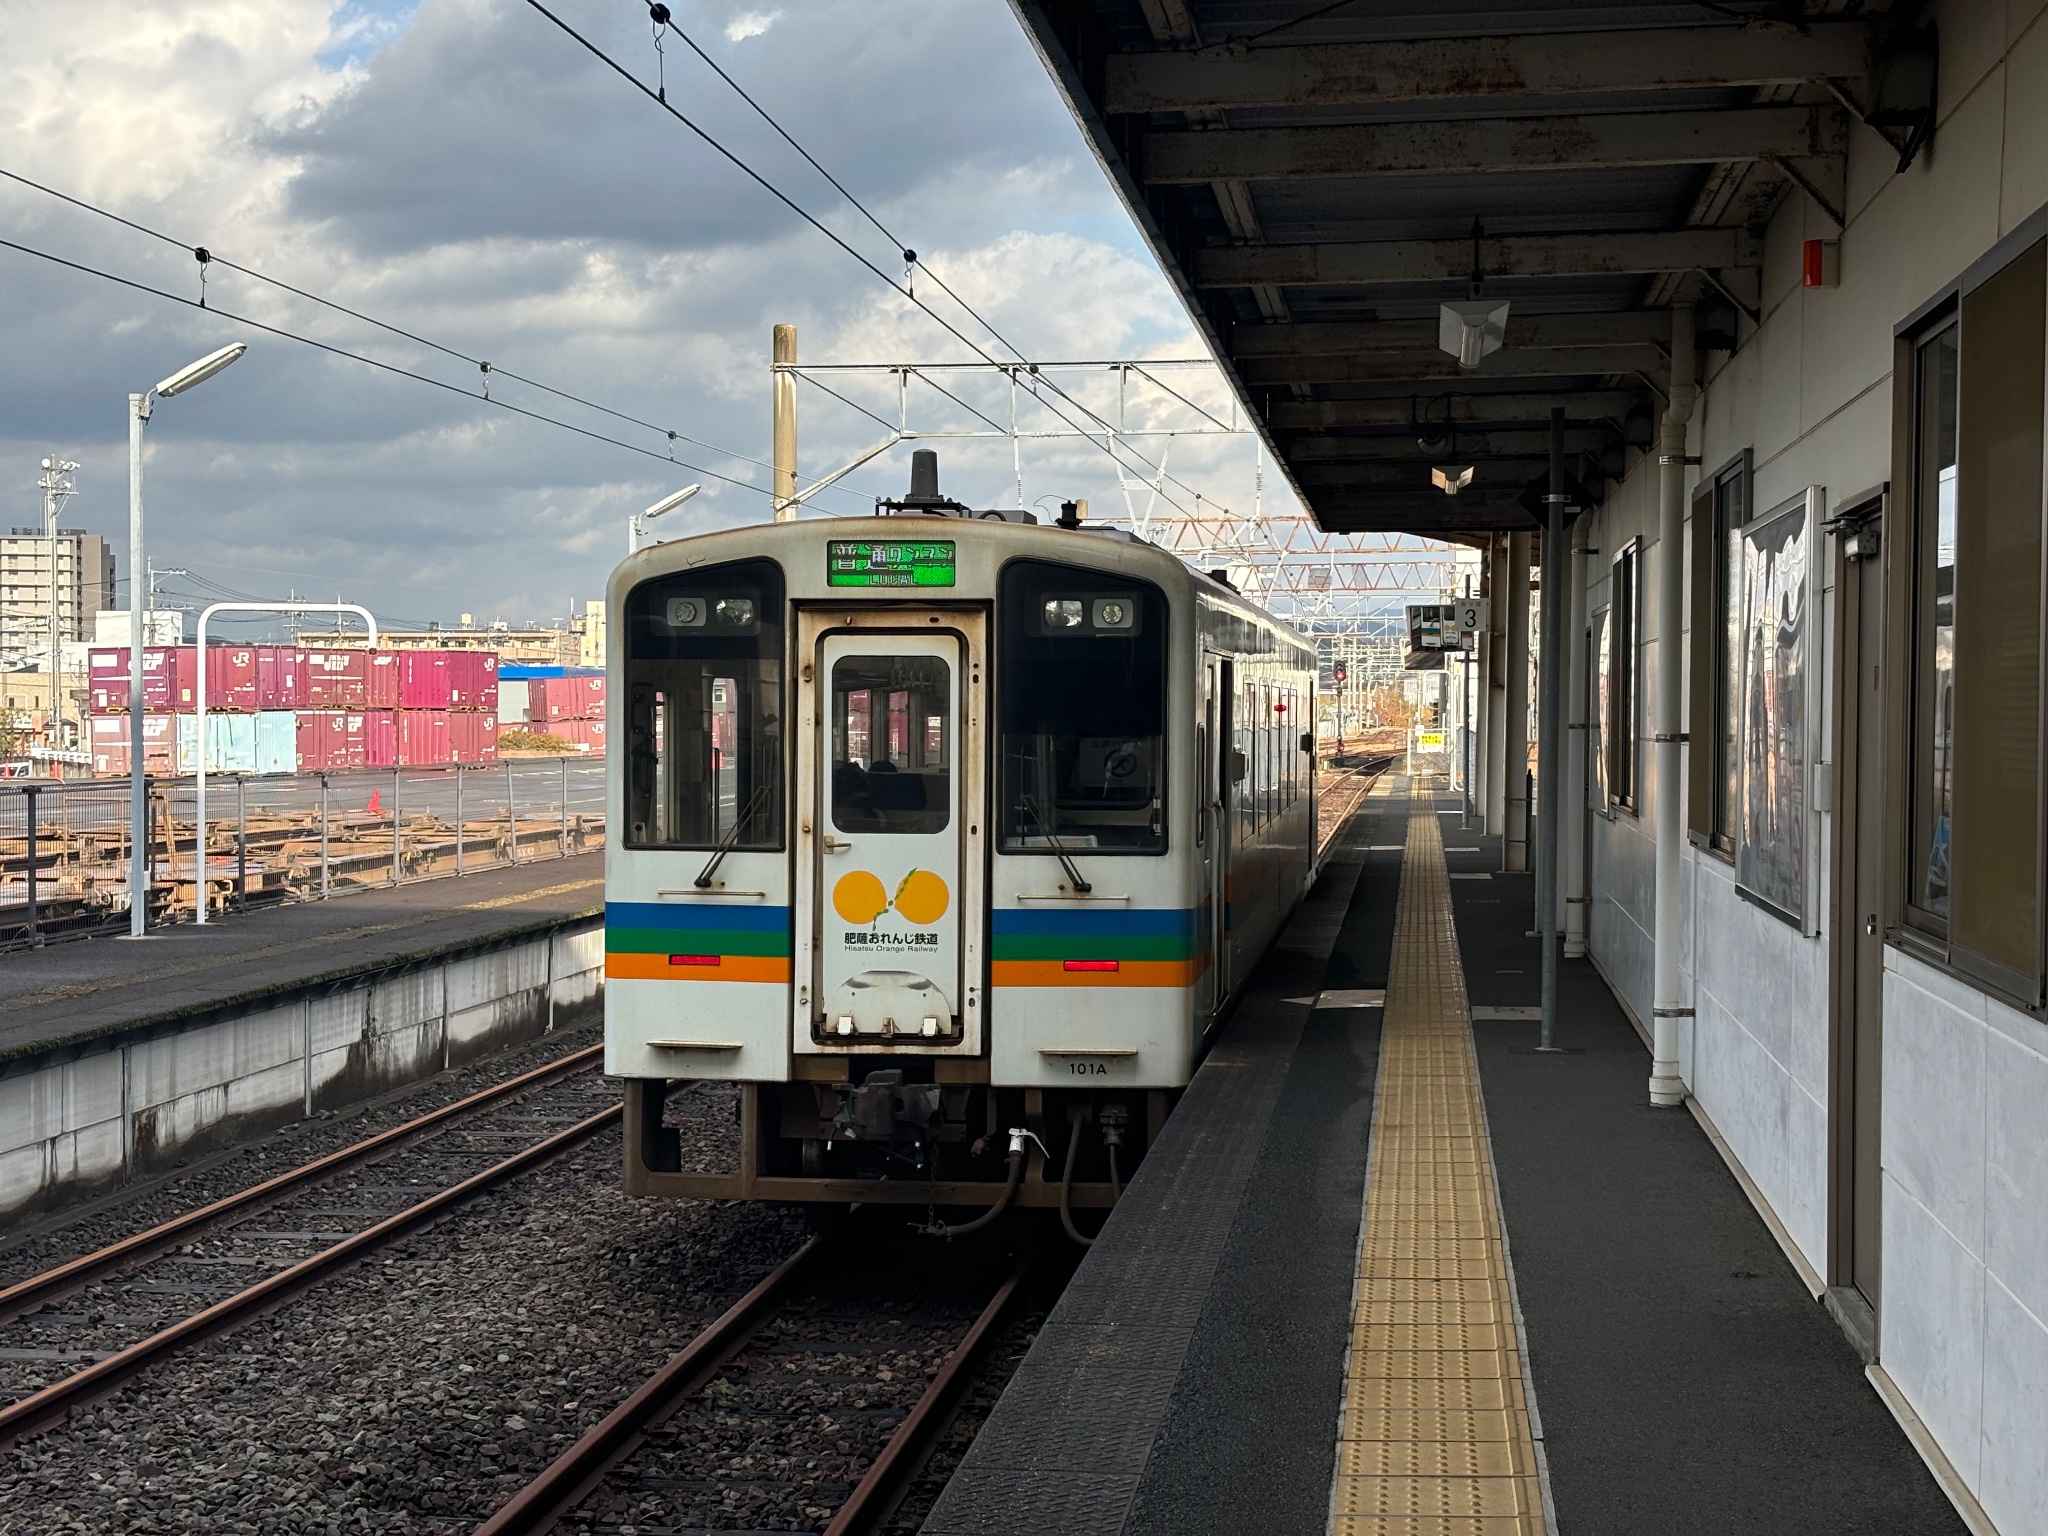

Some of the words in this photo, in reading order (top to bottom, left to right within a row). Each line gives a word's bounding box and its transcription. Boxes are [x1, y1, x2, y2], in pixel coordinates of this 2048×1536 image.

[1464, 608, 1476, 628] 3
[844, 932, 938, 945] 肥薩おれんじ鉄道
[876, 945, 905, 953] Orange
[1070, 1063, 1107, 1075] 101A
